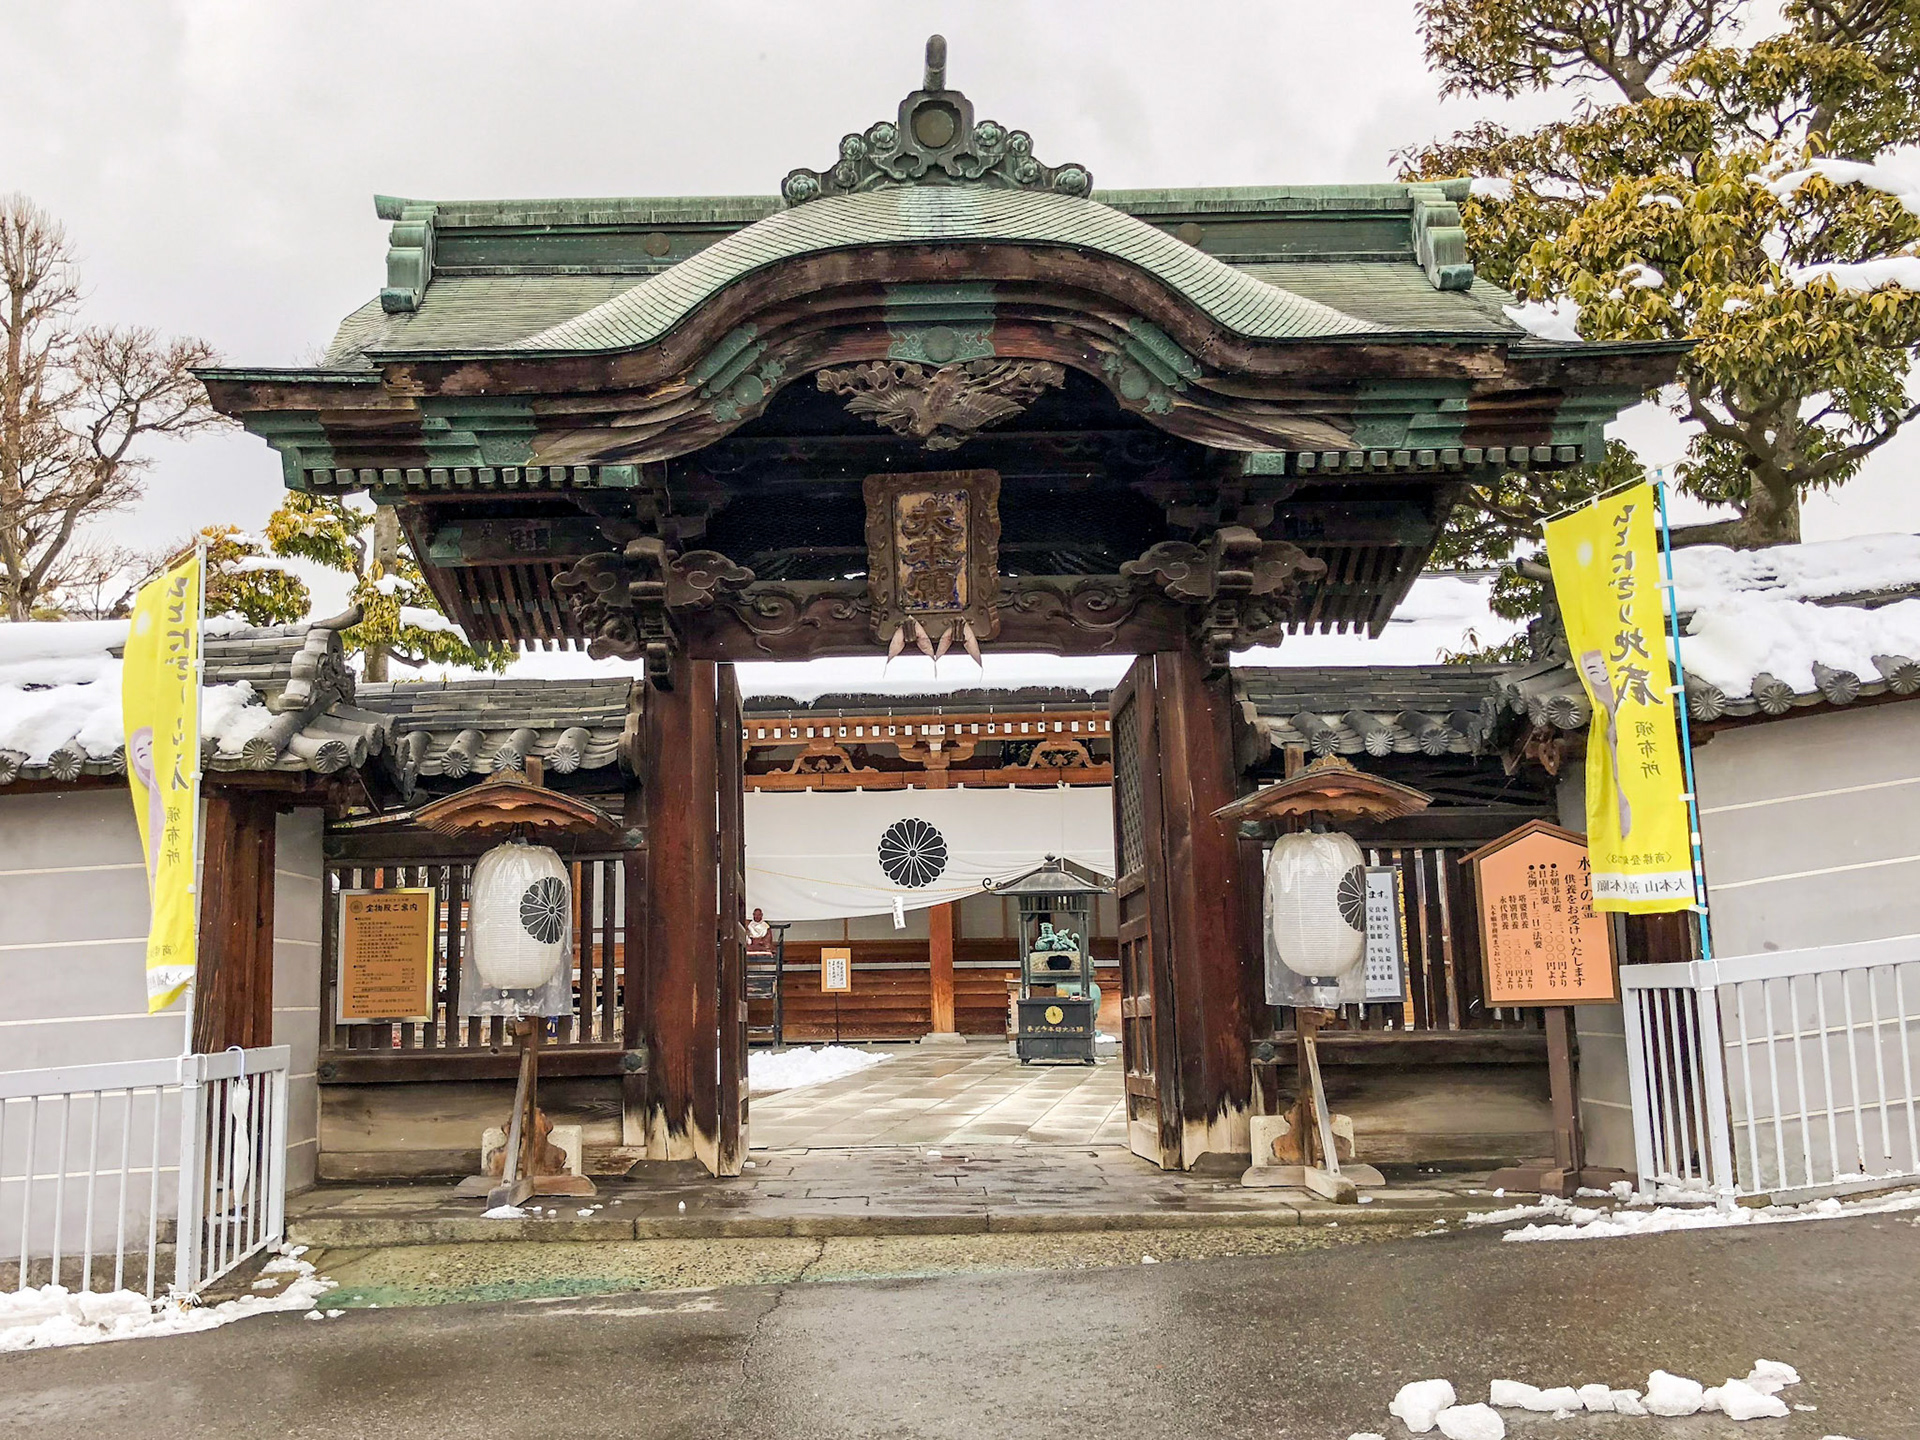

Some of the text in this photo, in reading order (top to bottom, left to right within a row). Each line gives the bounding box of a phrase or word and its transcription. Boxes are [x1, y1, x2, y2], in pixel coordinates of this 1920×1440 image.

[1538, 870, 1550, 905] 日中法要
[1549, 870, 1563, 913] お朝事法要
[365, 902, 418, 914] 宝物殿ご案内
[1499, 896, 1509, 931] 永代供養
[1508, 895, 1519, 930] 特別供養
[1518, 894, 1529, 929] 塔婆供養
[1564, 874, 1587, 989] 供養をお受けいたします
